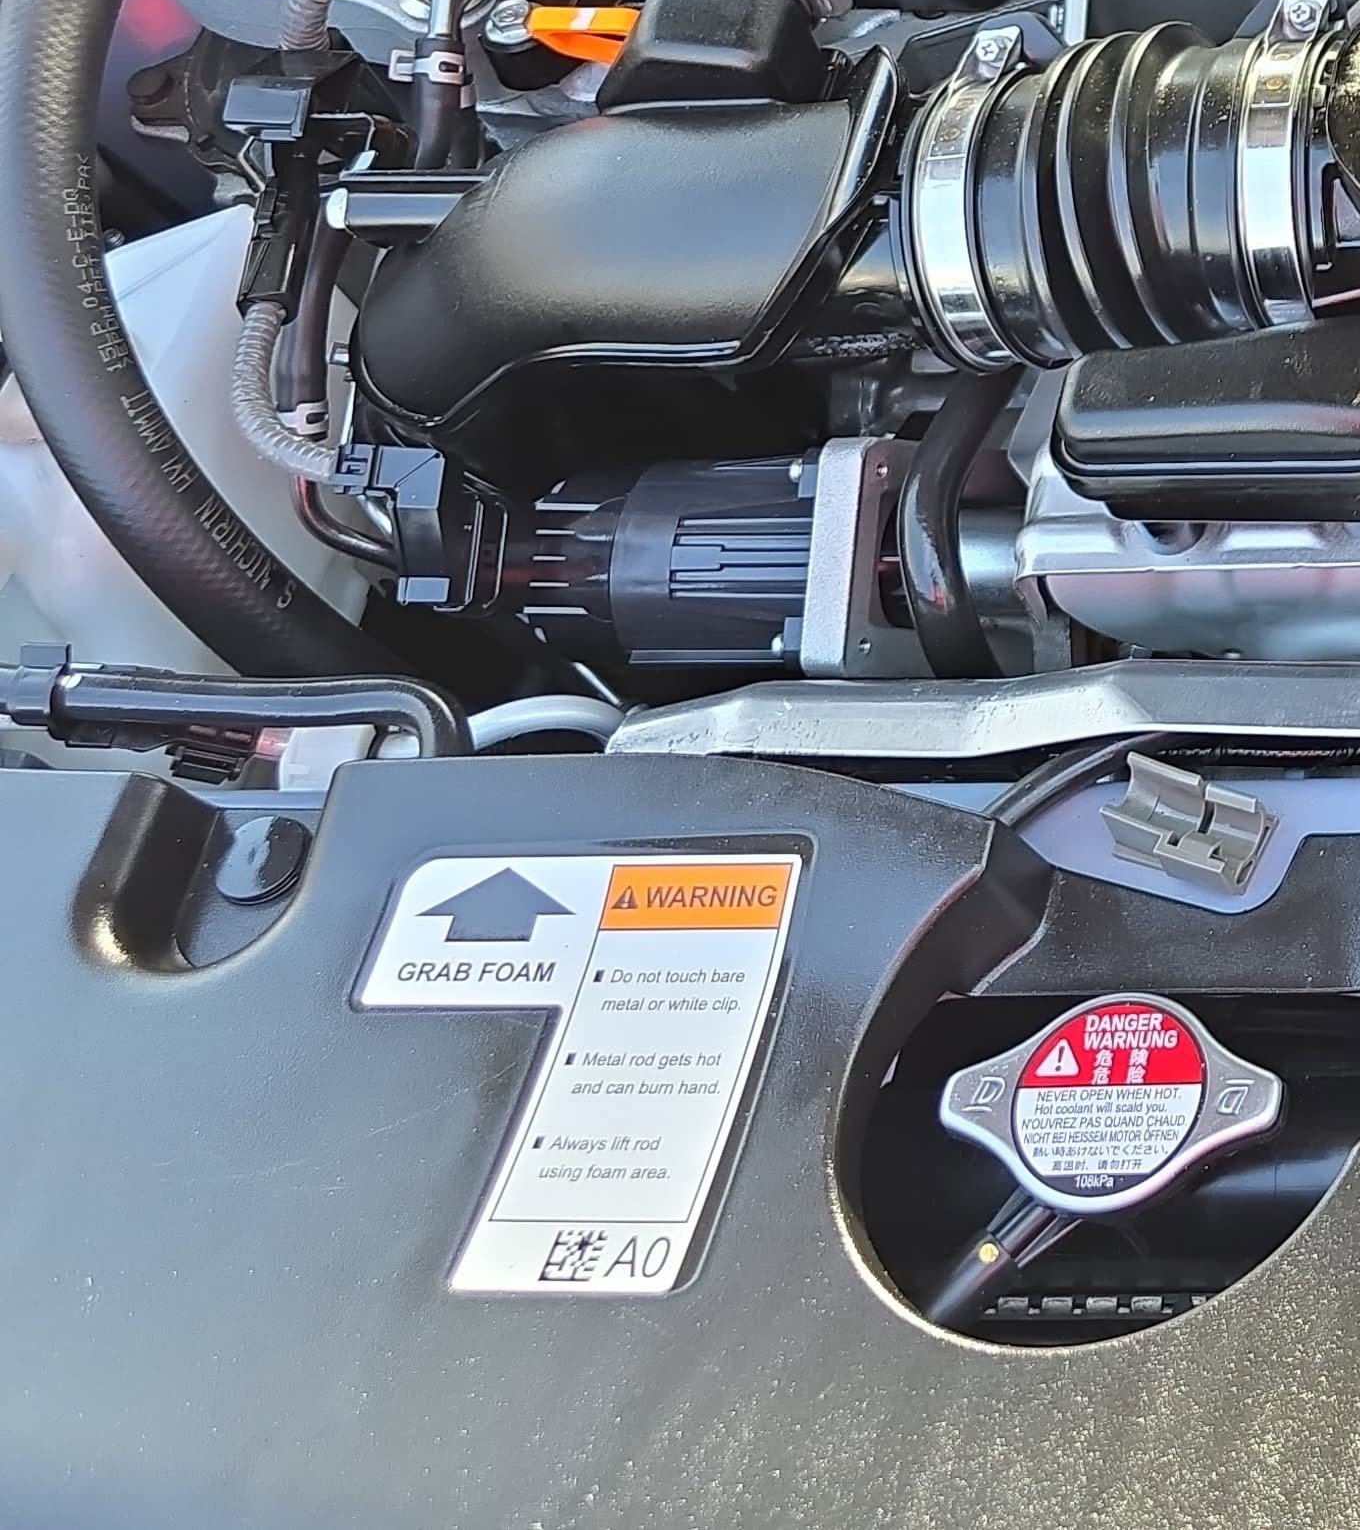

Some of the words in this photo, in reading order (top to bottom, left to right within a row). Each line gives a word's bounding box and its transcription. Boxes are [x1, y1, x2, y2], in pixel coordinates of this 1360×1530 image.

[194, 493, 280, 590] NICHIRIN
[646, 884, 777, 908] WARNING
[397, 962, 472, 983] GRAB
[478, 962, 556, 983] FOAM
[610, 969, 632, 983] Do
[636, 970, 662, 983] not
[665, 969, 707, 983] touch
[711, 969, 745, 983] bare
[602, 998, 644, 1012] metal
[649, 999, 665, 1012] or
[668, 998, 708, 1012] white
[712, 998, 742, 1014] clip.
[1085, 1013, 1163, 1032] DANGER
[1084, 1030, 1178, 1050] WARNUNG
[582, 1052, 624, 1066] Metal
[628, 1052, 654, 1066] rod
[658, 1053, 690, 1070] gets
[694, 1052, 721, 1066] hot
[571, 1080, 602, 1095] and
[606, 1083, 634, 1095] can
[638, 1080, 674, 1095] burn
[678, 1080, 721, 1095] hand.
[1037, 1090, 1077, 1102] NEVER
[1080, 1089, 1113, 1101] OPEN
[1116, 1088, 1152, 1100] WHEN
[1154, 1088, 1182, 1099] HOT.
[1034, 1103, 1053, 1115] Hot
[1056, 1103, 1093, 1115] coolant
[1096, 1102, 1113, 1113] will
[1115, 1102, 1143, 1113] scald
[1146, 1104, 1167, 1115] you.
[1022, 1117, 1077, 1130] N'OUVREZ
[1079, 1117, 1100, 1128] PAS
[1104, 1116, 1143, 1128] QUAND
[550, 1137, 607, 1152] Always
[611, 1136, 629, 1151] lift
[634, 1137, 661, 1151] rod
[1024, 1132, 1050, 1144] NICHT
[1052, 1131, 1066, 1143] BEI
[1069, 1131, 1107, 1143] HEISSEM
[1109, 1130, 1140, 1142] MOTOR
[539, 1165, 581, 1181] using
[585, 1165, 626, 1179] foam
[631, 1167, 671, 1179] area.
[1075, 1175, 1115, 1189] 108kPa
[604, 1237, 671, 1278] A0
